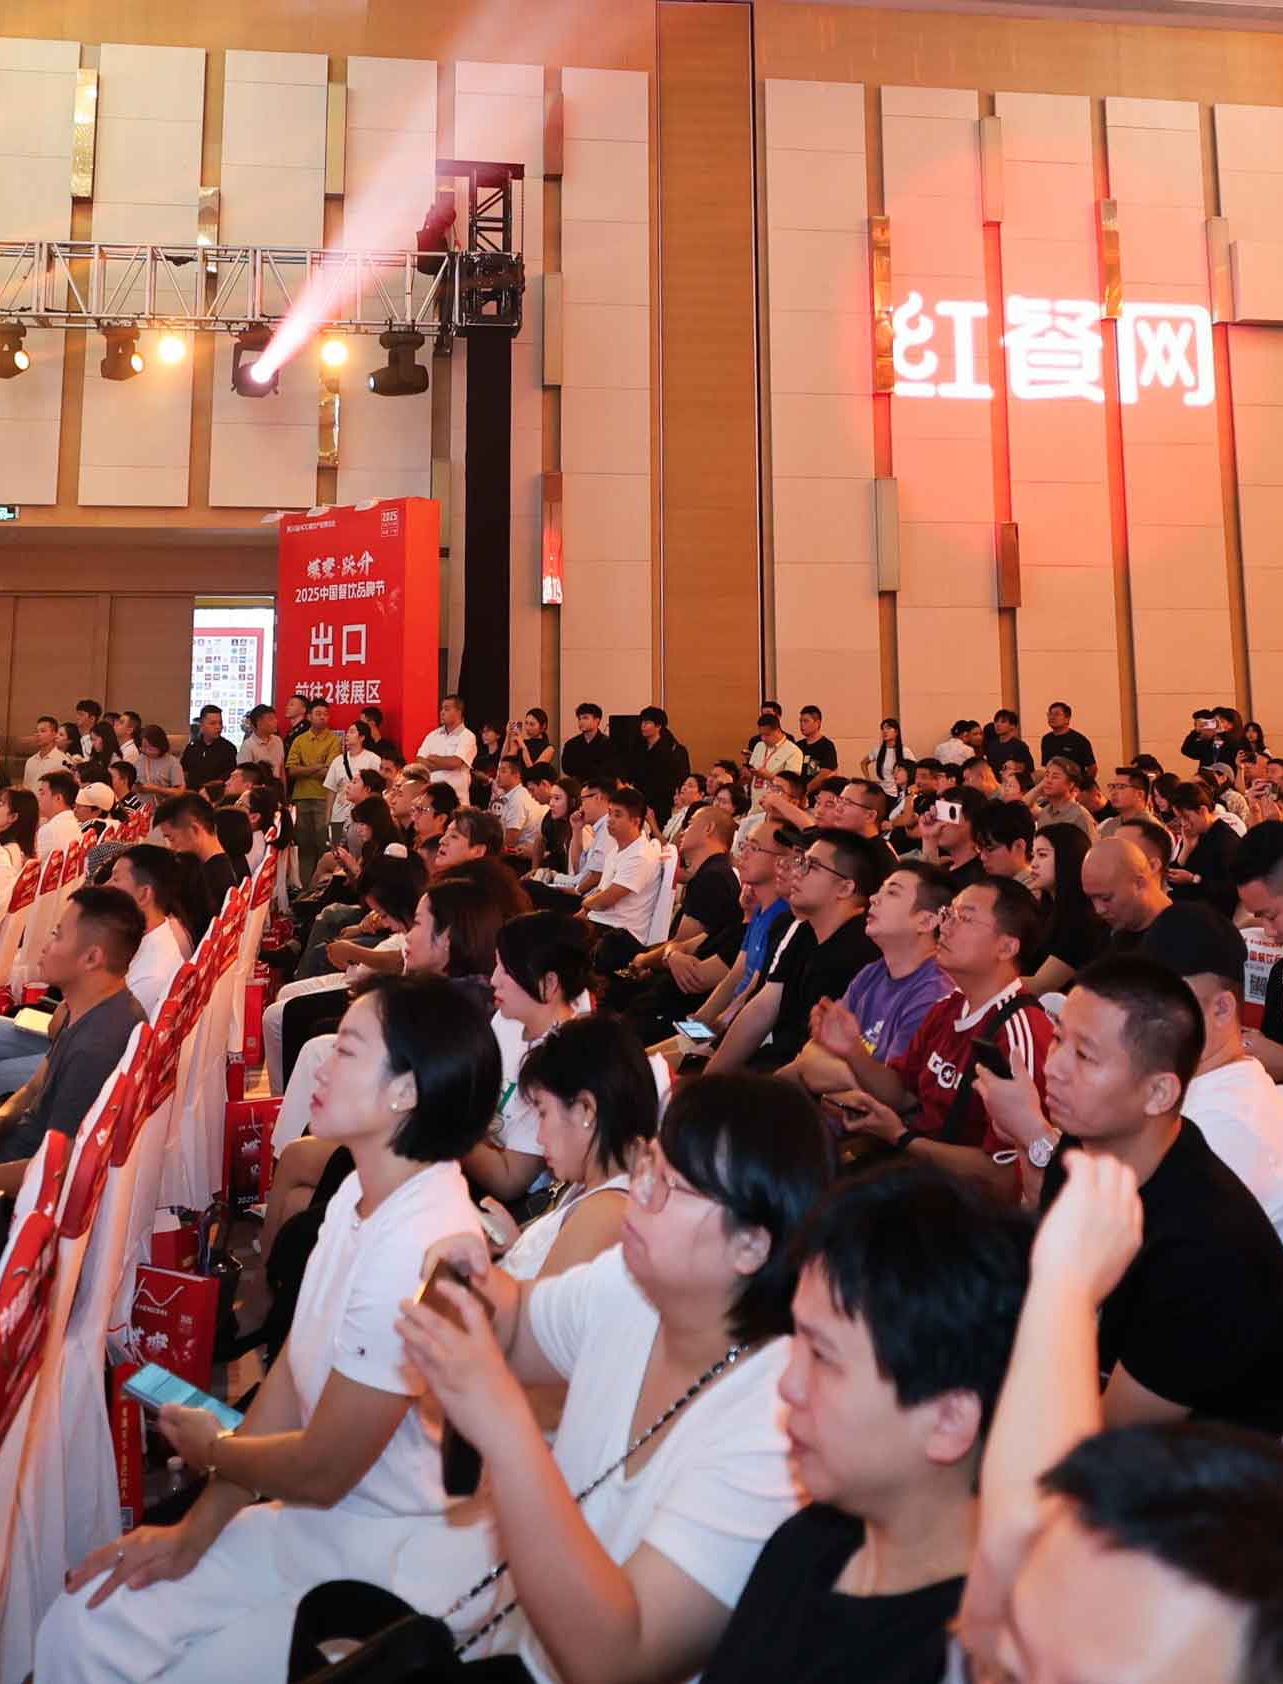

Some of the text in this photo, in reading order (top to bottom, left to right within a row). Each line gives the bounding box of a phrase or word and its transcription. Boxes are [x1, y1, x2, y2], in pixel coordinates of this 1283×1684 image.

[892, 292, 1215, 405] 红餐网
[295, 580, 385, 603] 2025中国餐饮品牌节
[309, 621, 367, 667] 出口
[295, 679, 381, 704] 前往2楼展区
